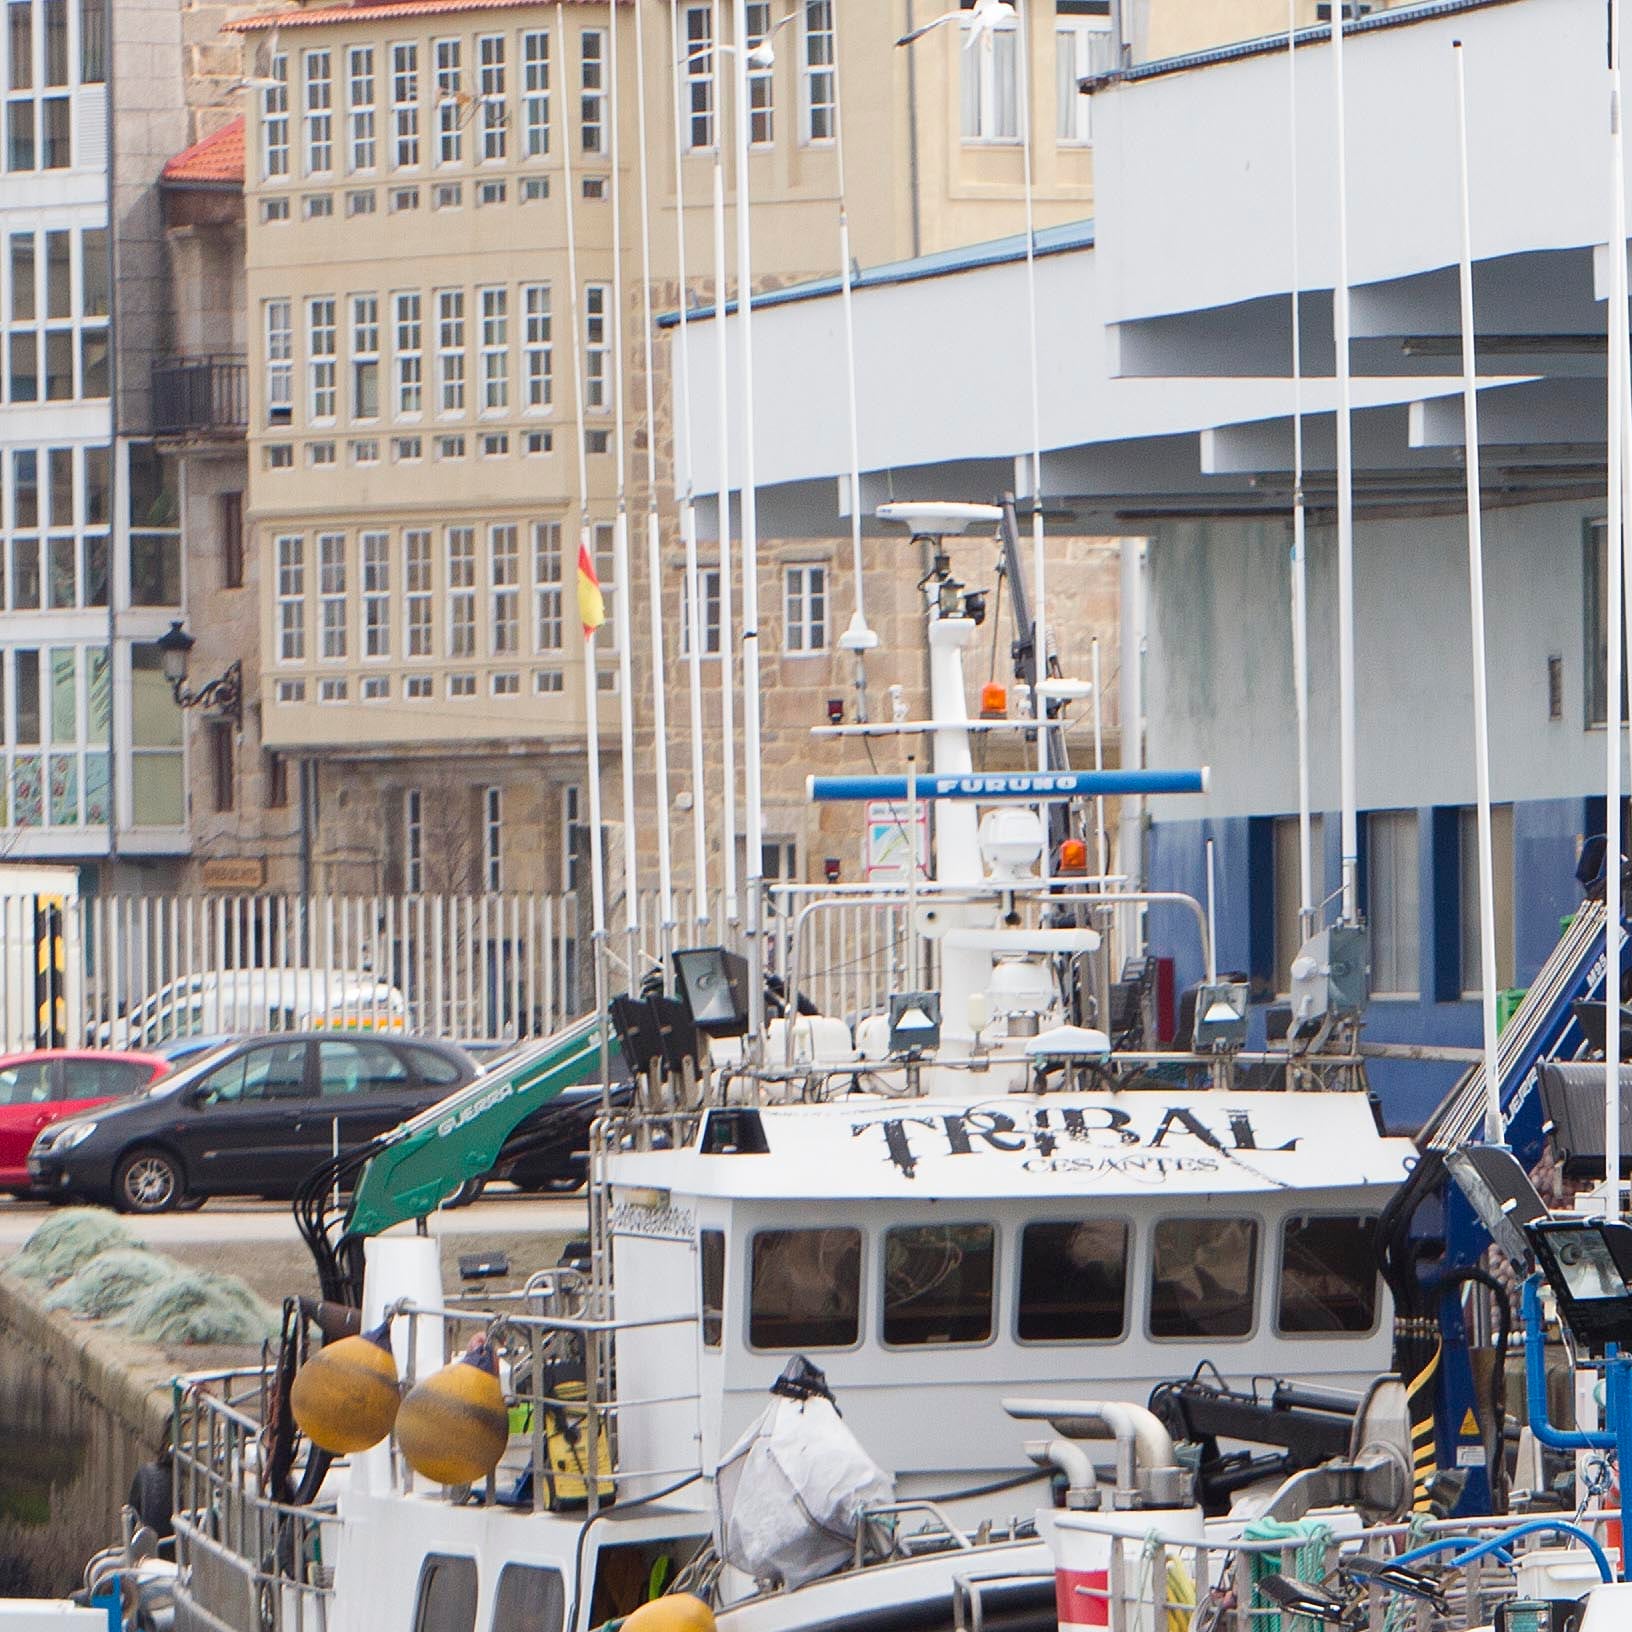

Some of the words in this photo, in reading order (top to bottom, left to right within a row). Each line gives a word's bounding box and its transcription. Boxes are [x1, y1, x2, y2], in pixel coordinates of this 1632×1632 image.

[936, 775, 1078, 794] FURUNO
[437, 1080, 514, 1138] GUERRA
[851, 1104, 1303, 1180] TRIBAL
[1021, 1156, 1220, 1181] CESANTES
